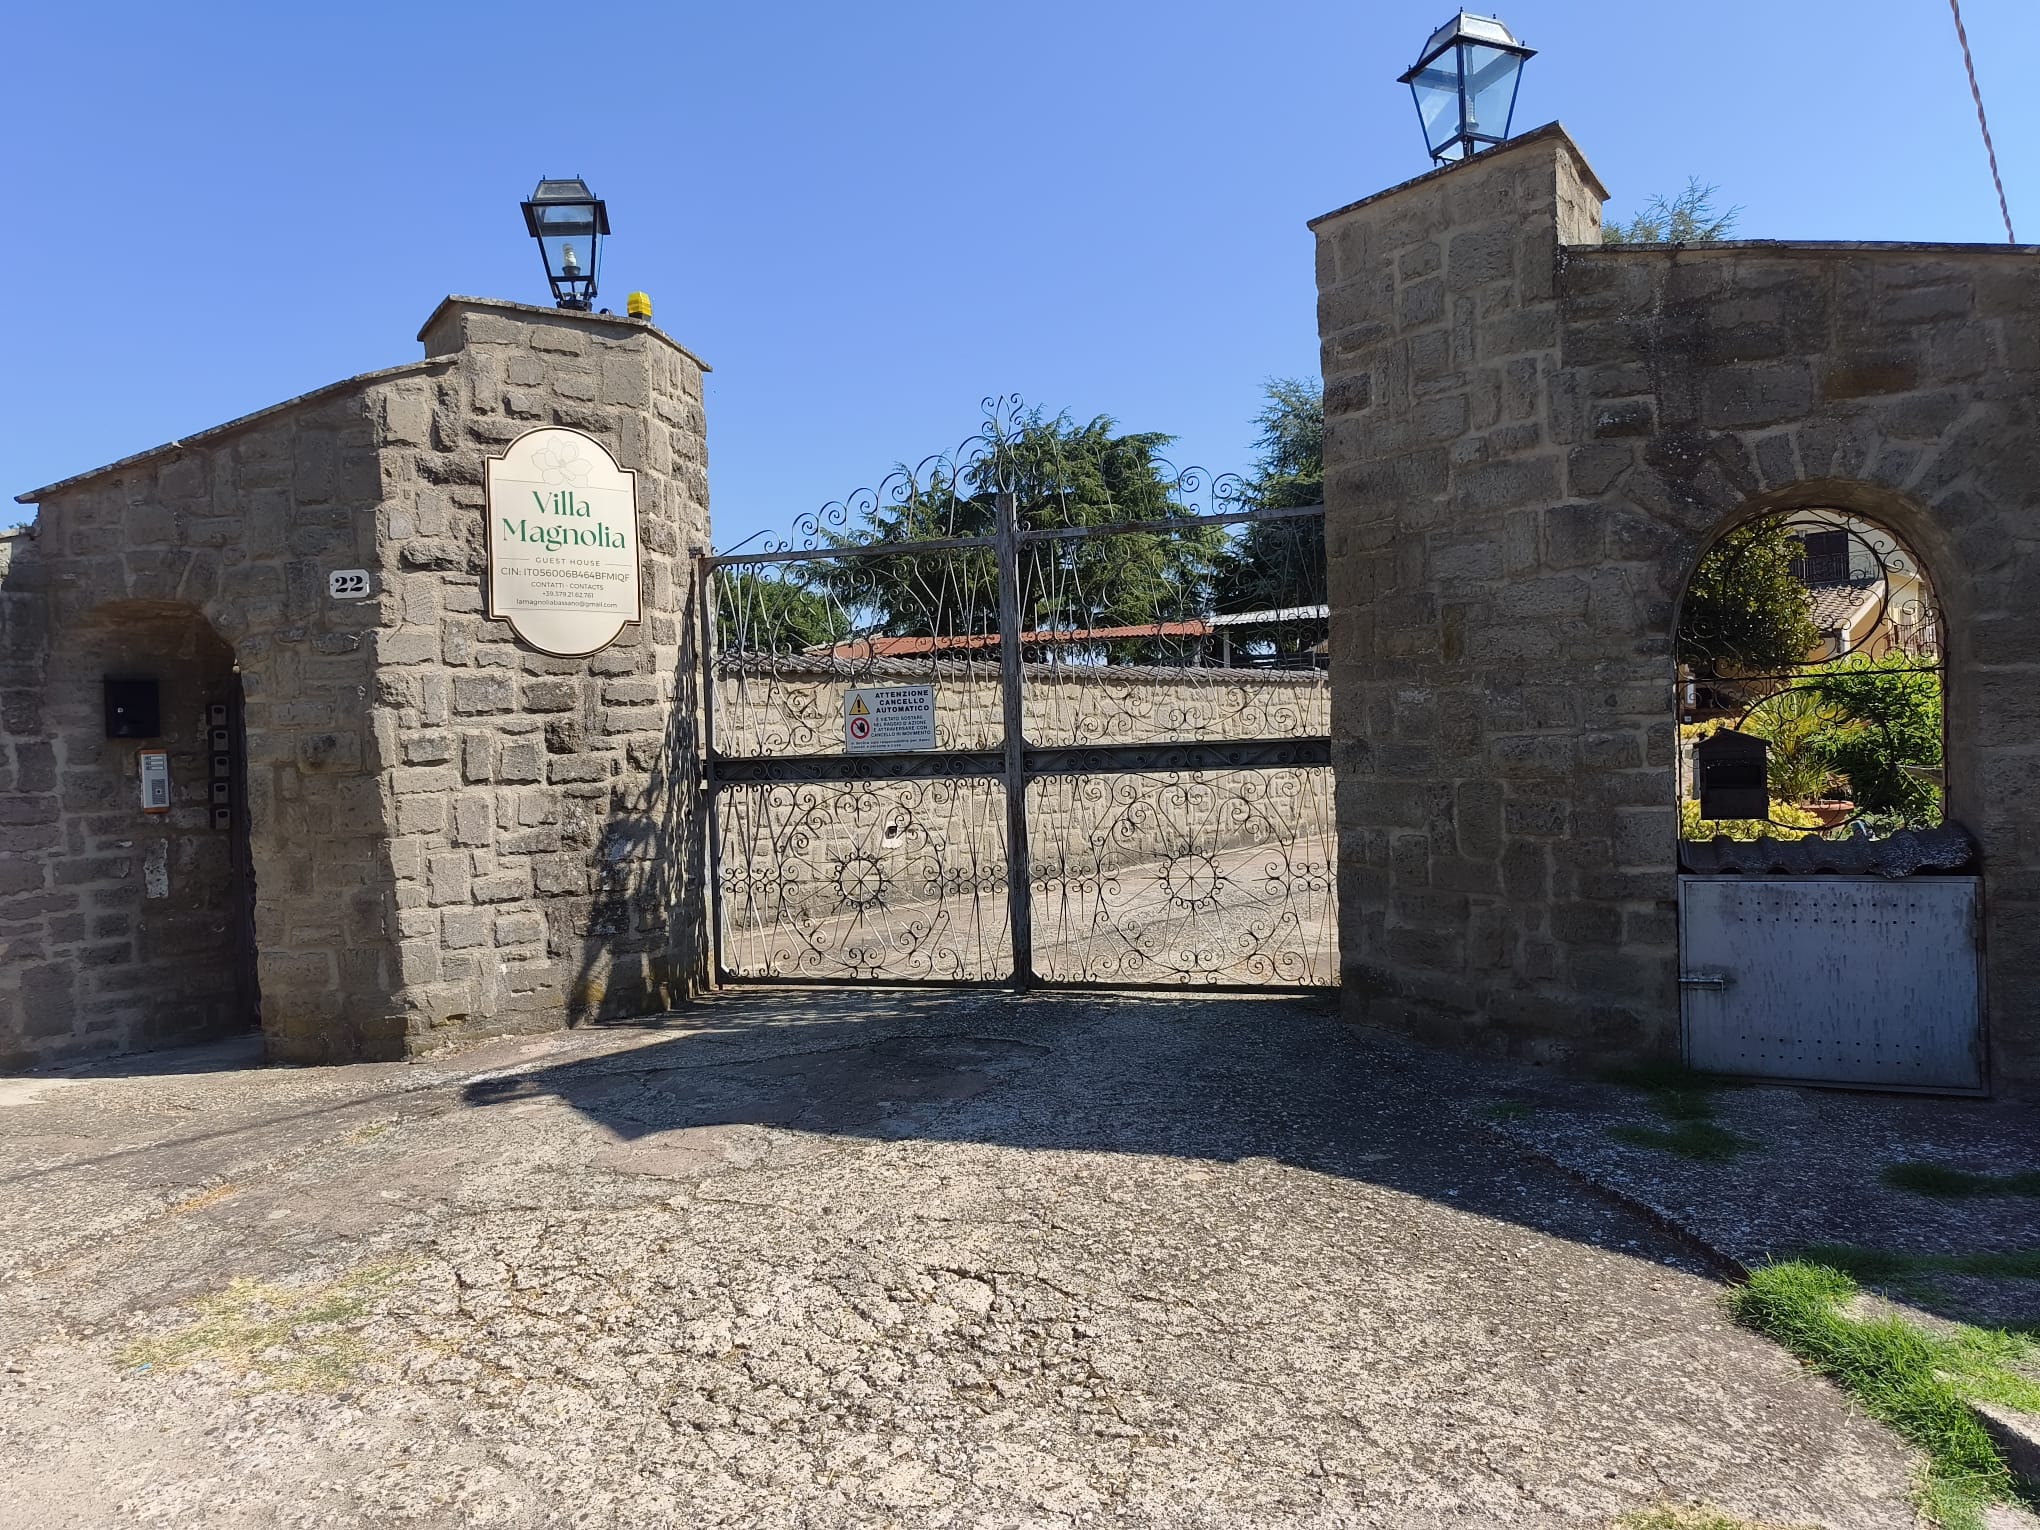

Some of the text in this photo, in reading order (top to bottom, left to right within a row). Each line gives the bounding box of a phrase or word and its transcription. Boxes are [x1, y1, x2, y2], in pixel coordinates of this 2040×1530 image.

[532, 490, 591, 518] Villa
[502, 518, 626, 552] Magnolia
[535, 557, 601, 567] GUEST HOUSE
[500, 567, 521, 576] CIN:
[334, 575, 364, 593] 22
[531, 581, 565, 589] CONTATTI
[569, 582, 604, 591] CONTACTS
[875, 689, 929, 699] ATTENZIONE
[879, 697, 925, 706] CANCELLO
[876, 705, 930, 714] AUTOMATICO
